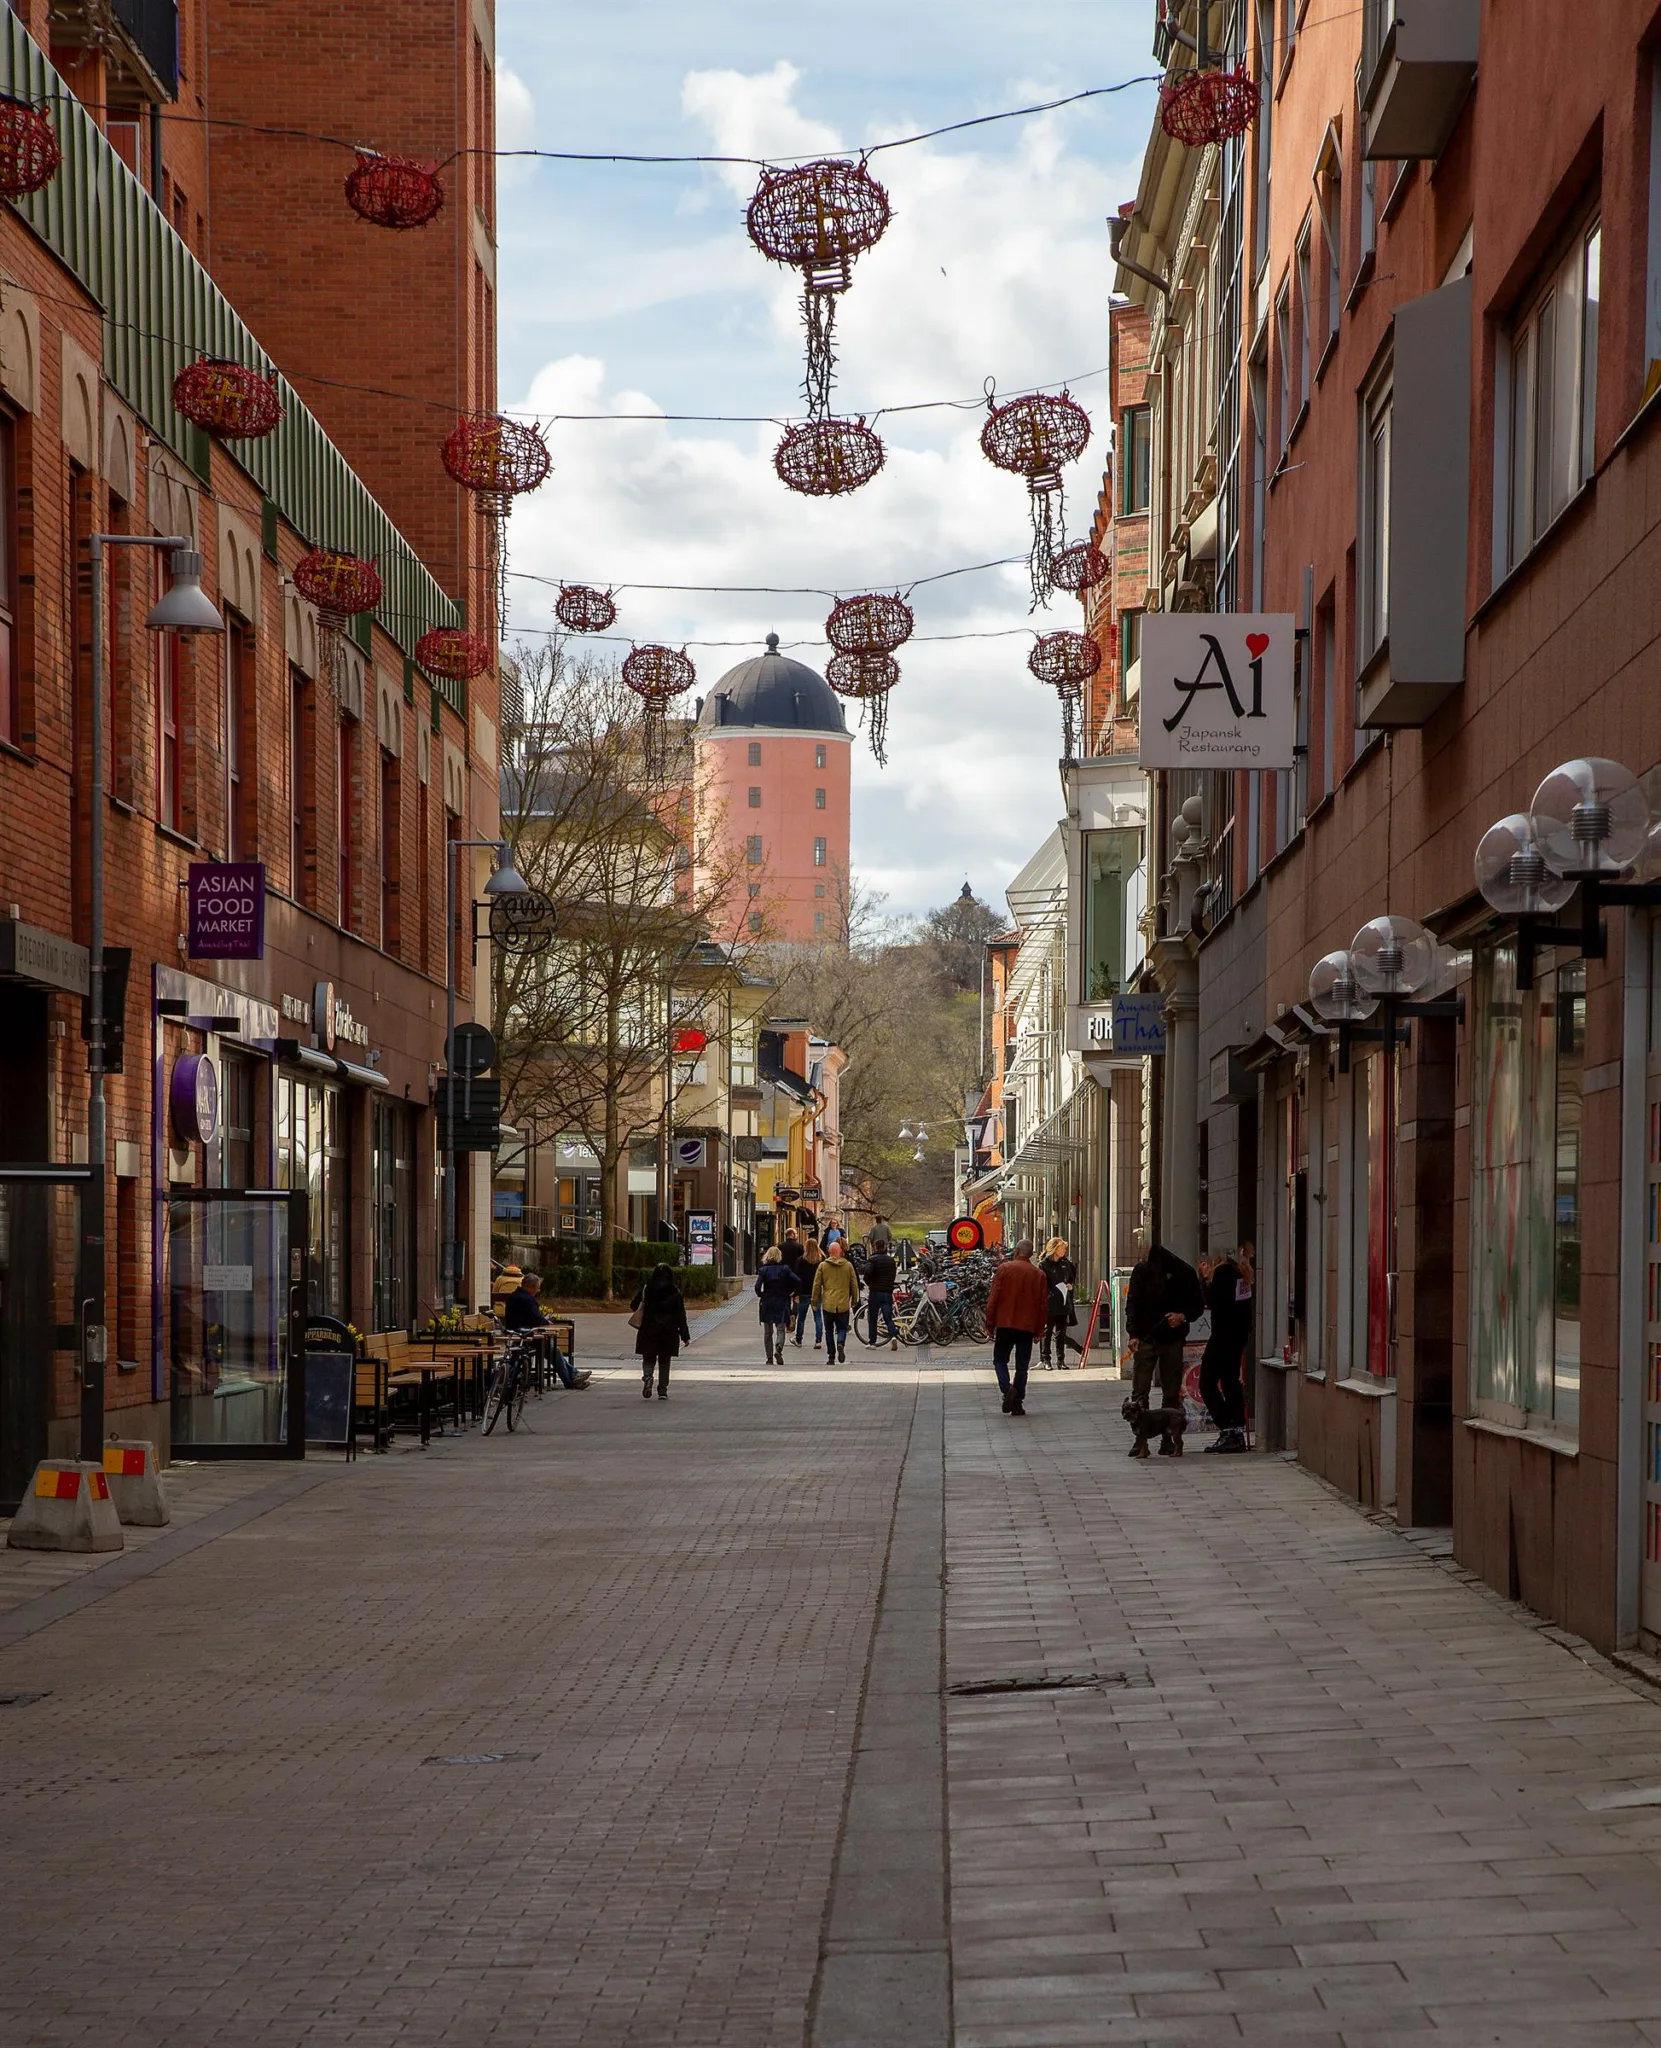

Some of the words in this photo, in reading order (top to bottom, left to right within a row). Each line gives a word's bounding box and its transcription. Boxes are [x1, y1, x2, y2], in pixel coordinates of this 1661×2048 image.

[1163, 633, 1270, 732] Ai
[1179, 725, 1242, 741] Japansk
[1177, 740, 1261, 757] Restaurang
[197, 876, 254, 892] ASIAN
[197, 898, 254, 915] FOOD
[197, 920, 253, 932] MARKET
[198, 939, 233, 951] Amazing
